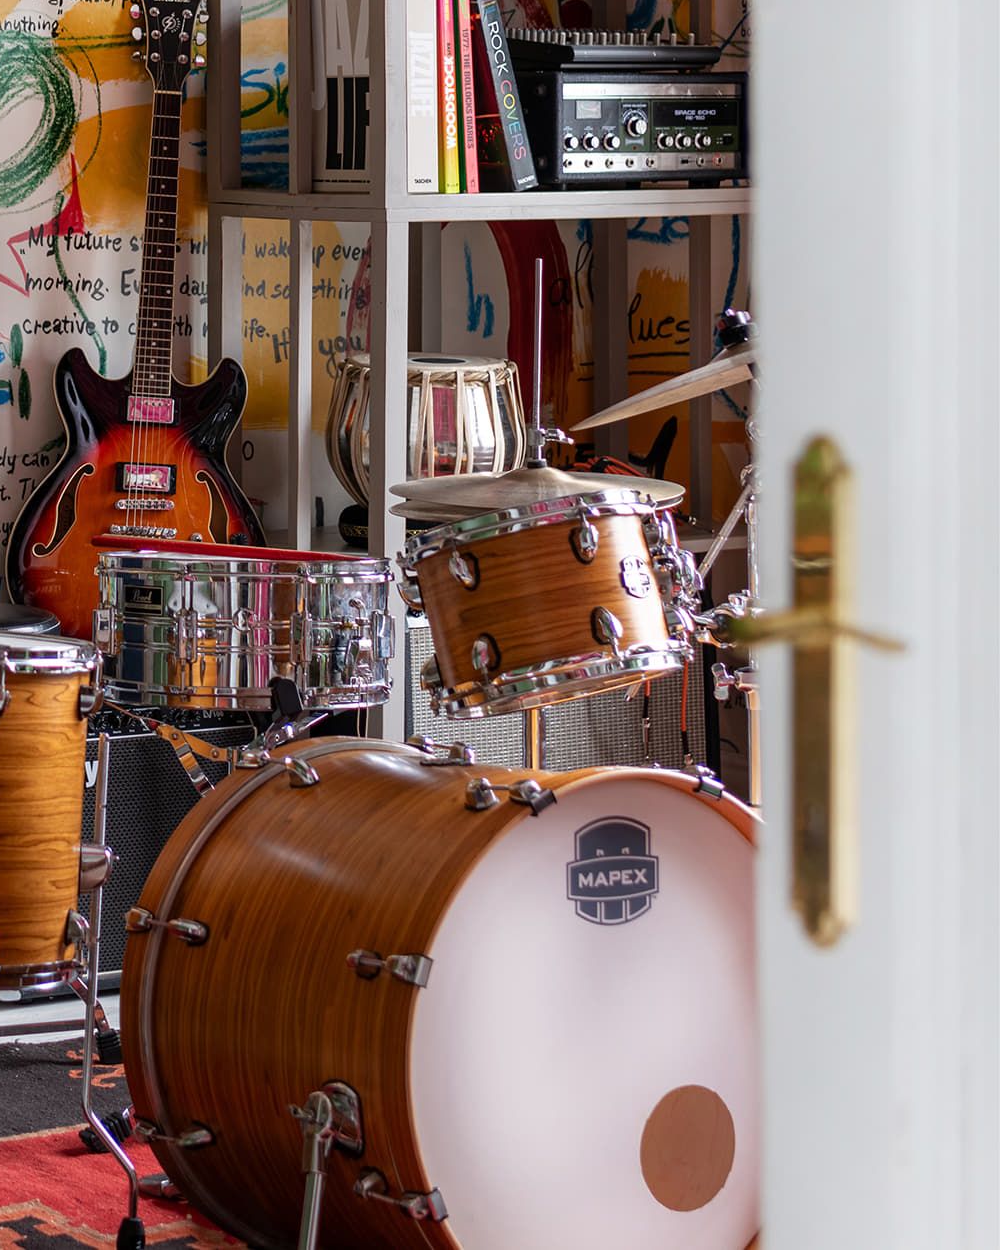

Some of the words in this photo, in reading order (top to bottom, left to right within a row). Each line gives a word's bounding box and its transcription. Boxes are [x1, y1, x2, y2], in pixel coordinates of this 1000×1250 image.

[442, 55, 459, 150] WOODSTOCK
[487, 21, 508, 76] ROCK
[500, 79, 527, 161] COVERS
[64, 225, 123, 252] future
[24, 270, 112, 301] morning.
[22, 315, 98, 338] creative
[102, 315, 121, 337] to
[21, 453, 51, 468] can
[578, 867, 649, 890] MAPEX
